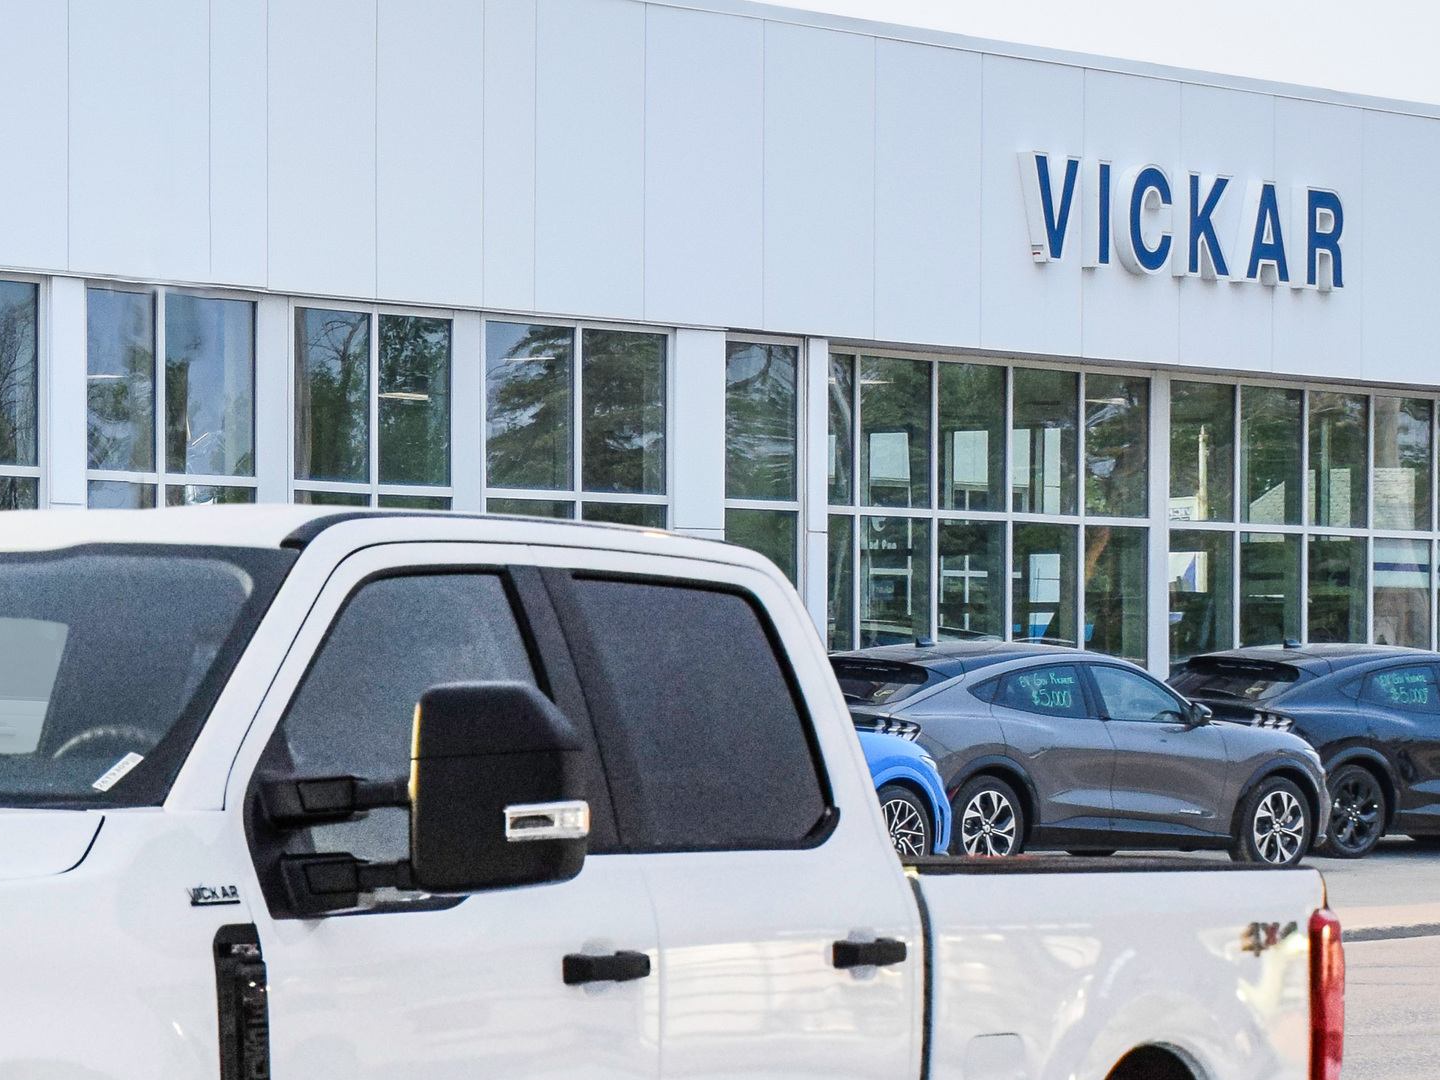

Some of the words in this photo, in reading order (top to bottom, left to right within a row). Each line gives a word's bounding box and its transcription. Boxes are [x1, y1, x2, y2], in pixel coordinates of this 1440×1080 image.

[1030, 151, 1345, 289] VICKAR
[1032, 688, 1073, 708] $5,000
[186, 884, 240, 902] VICKAR
